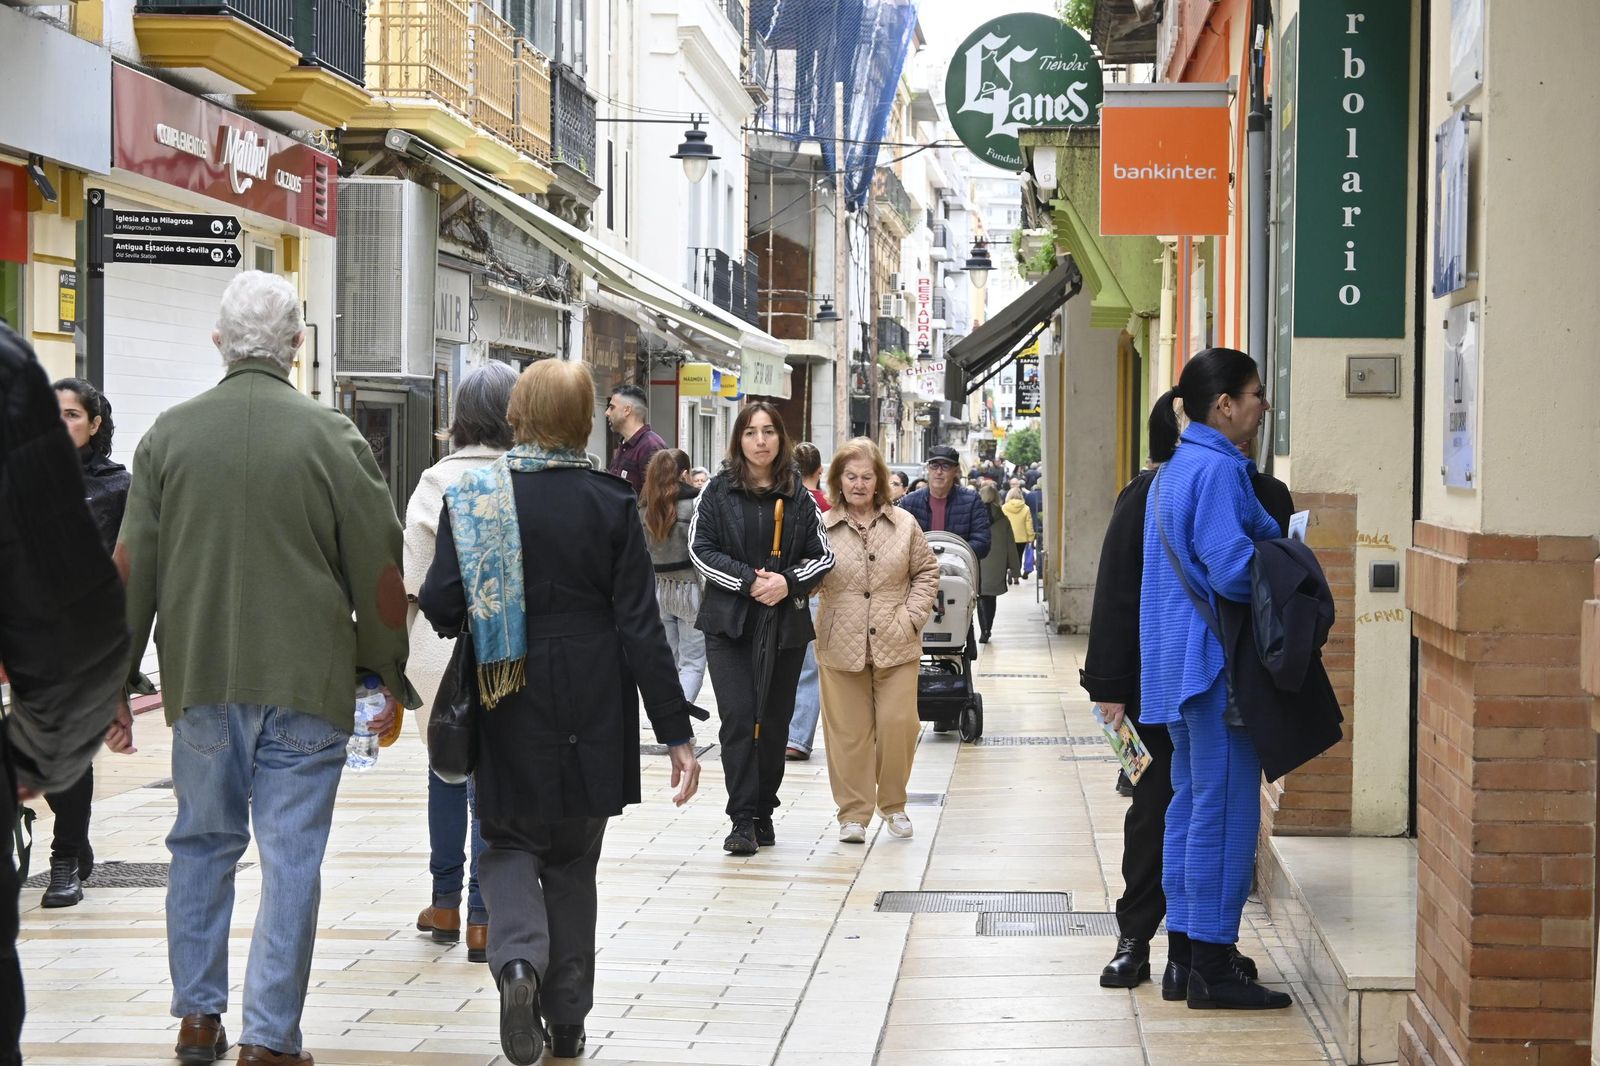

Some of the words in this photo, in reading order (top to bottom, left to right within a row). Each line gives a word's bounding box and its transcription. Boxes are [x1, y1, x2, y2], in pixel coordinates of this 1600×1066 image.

[1039, 53, 1088, 71] Tiendas
[115, 214, 139, 223] Iglesia
[140, 215, 150, 223] de
[160, 216, 194, 226] Milagrosa
[115, 243, 143, 251] Antigua
[145, 243, 174, 252] Estación
[176, 245, 185, 253] de
[186, 245, 209, 254] Sevilla
